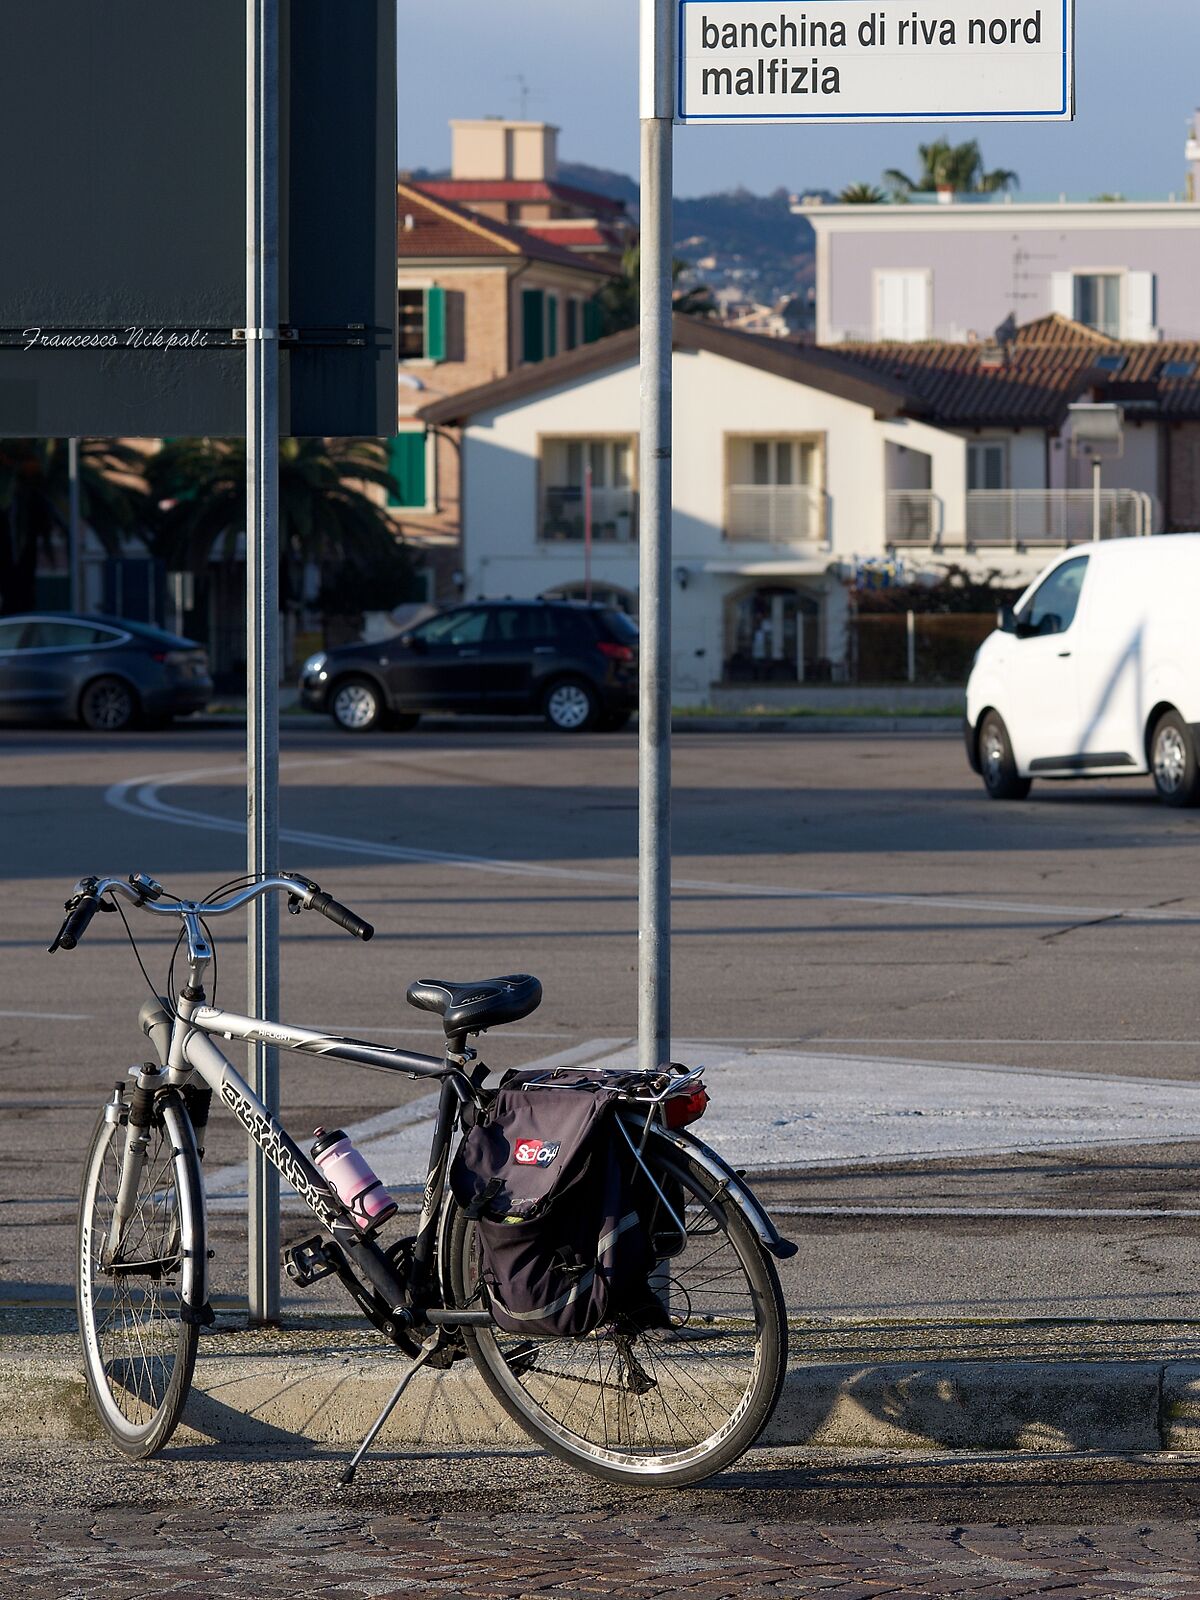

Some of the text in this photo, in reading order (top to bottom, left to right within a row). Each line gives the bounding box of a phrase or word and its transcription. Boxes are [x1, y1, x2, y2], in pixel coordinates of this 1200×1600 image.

[701, 10, 1042, 49] banchina di riva nord
[701, 58, 841, 95] malfizia
